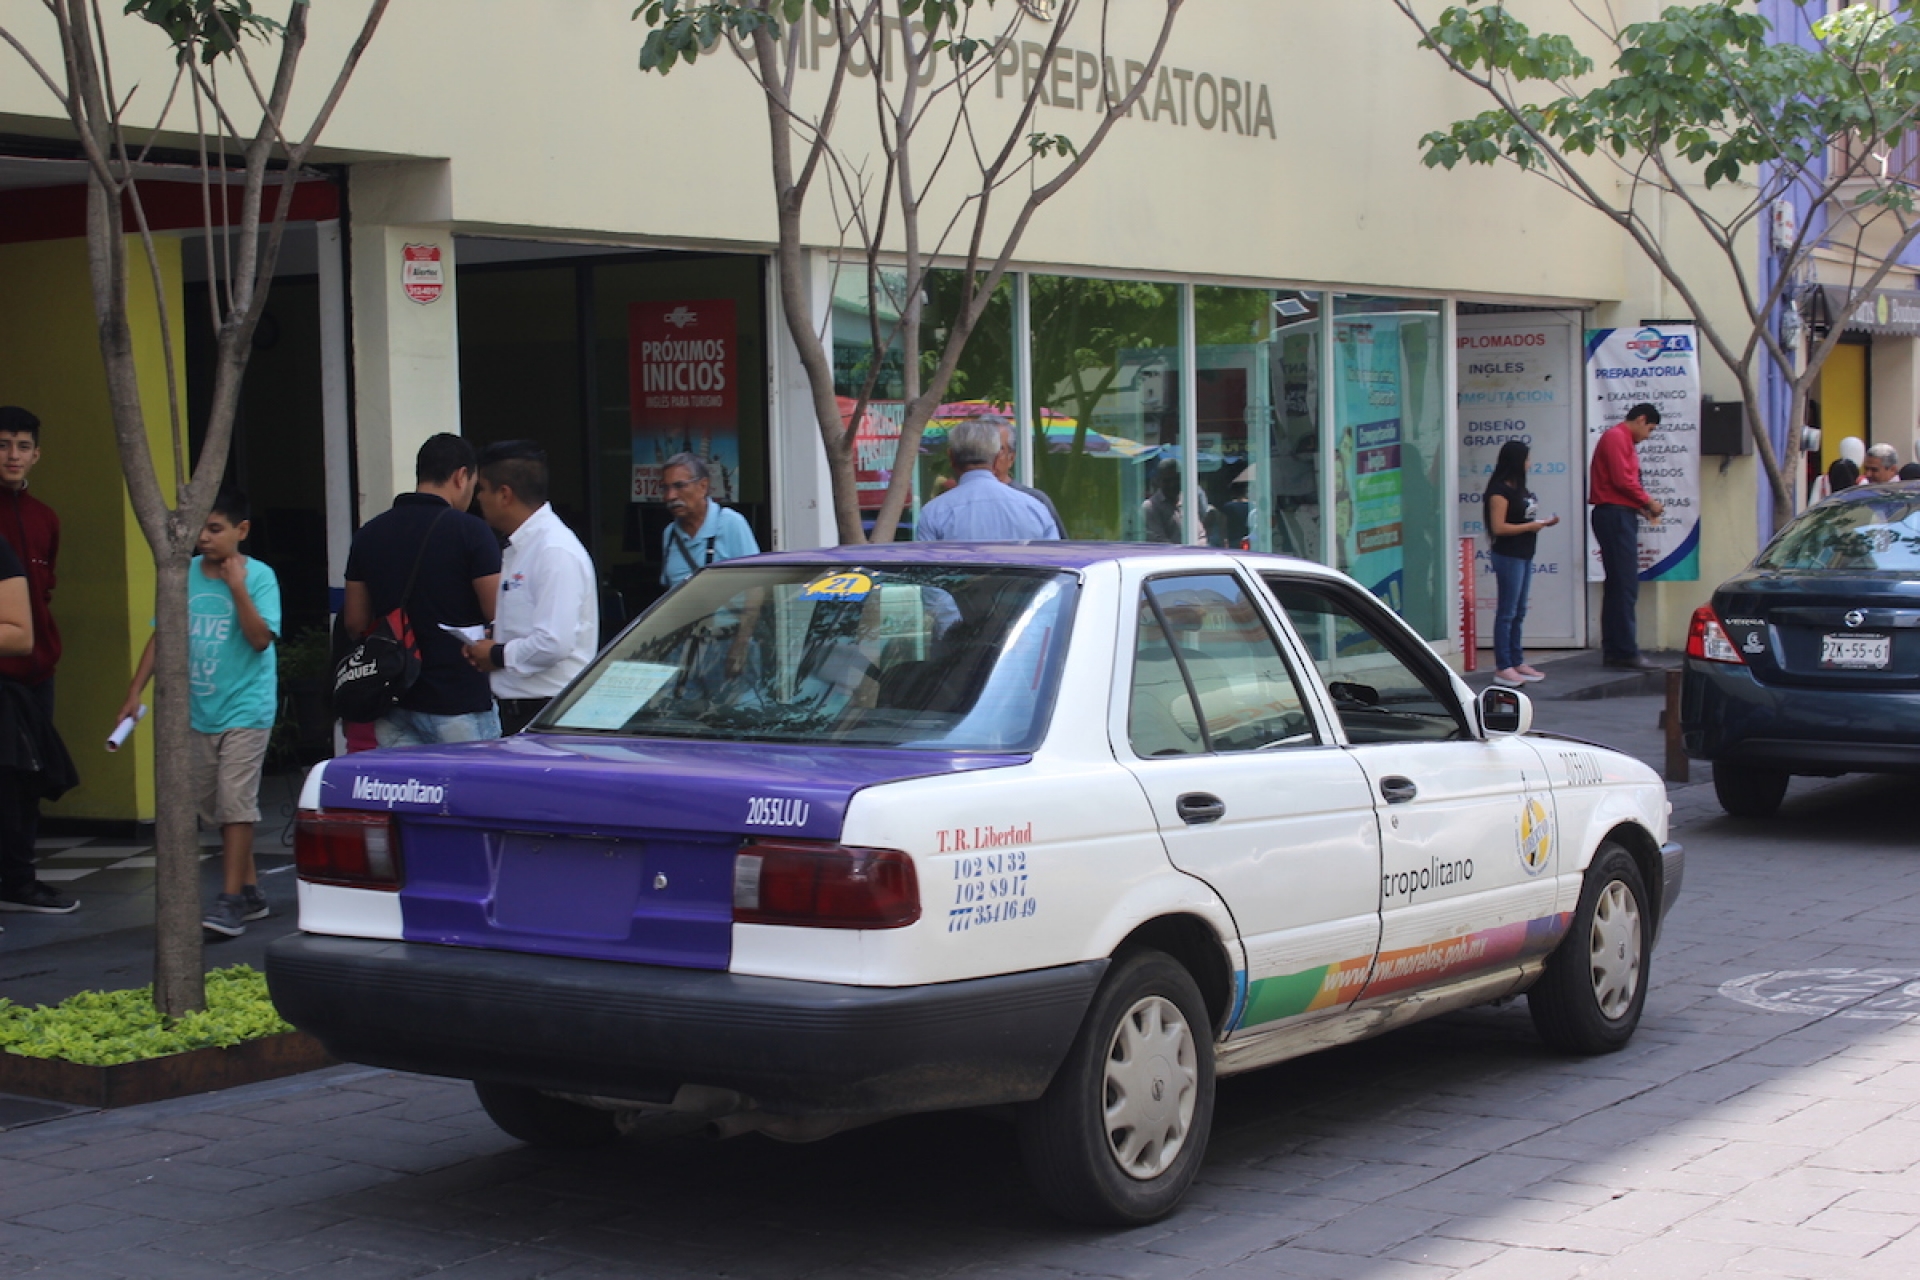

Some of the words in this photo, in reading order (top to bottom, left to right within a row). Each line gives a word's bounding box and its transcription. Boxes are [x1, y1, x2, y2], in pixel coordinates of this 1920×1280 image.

[994, 36, 1277, 140] PREPARATORIA
[642, 334, 725, 362] PRÓXIMOS
[1457, 333, 1546, 350] IPLOMADOS
[643, 362, 725, 392] INICIOS
[1468, 362, 1524, 375] INGLES
[1595, 365, 1687, 380] PREPARATORIA
[1634, 380, 1648, 388] EN
[671, 395, 690, 407] PARA
[691, 395, 723, 407] TURISMO
[1607, 391, 1650, 402] EXAMEN
[1652, 388, 1687, 400] ÚNICO
[1468, 419, 1526, 432] DISEÑO
[825, 577, 858, 590] 21
[189, 617, 231, 641] AVE
[1724, 618, 1766, 627] VERSA
[351, 774, 444, 804] Metropolitano
[745, 796, 810, 828] 2055LUU
[974, 821, 1033, 849] Libertad
[1382, 855, 1474, 904] tropolitano
